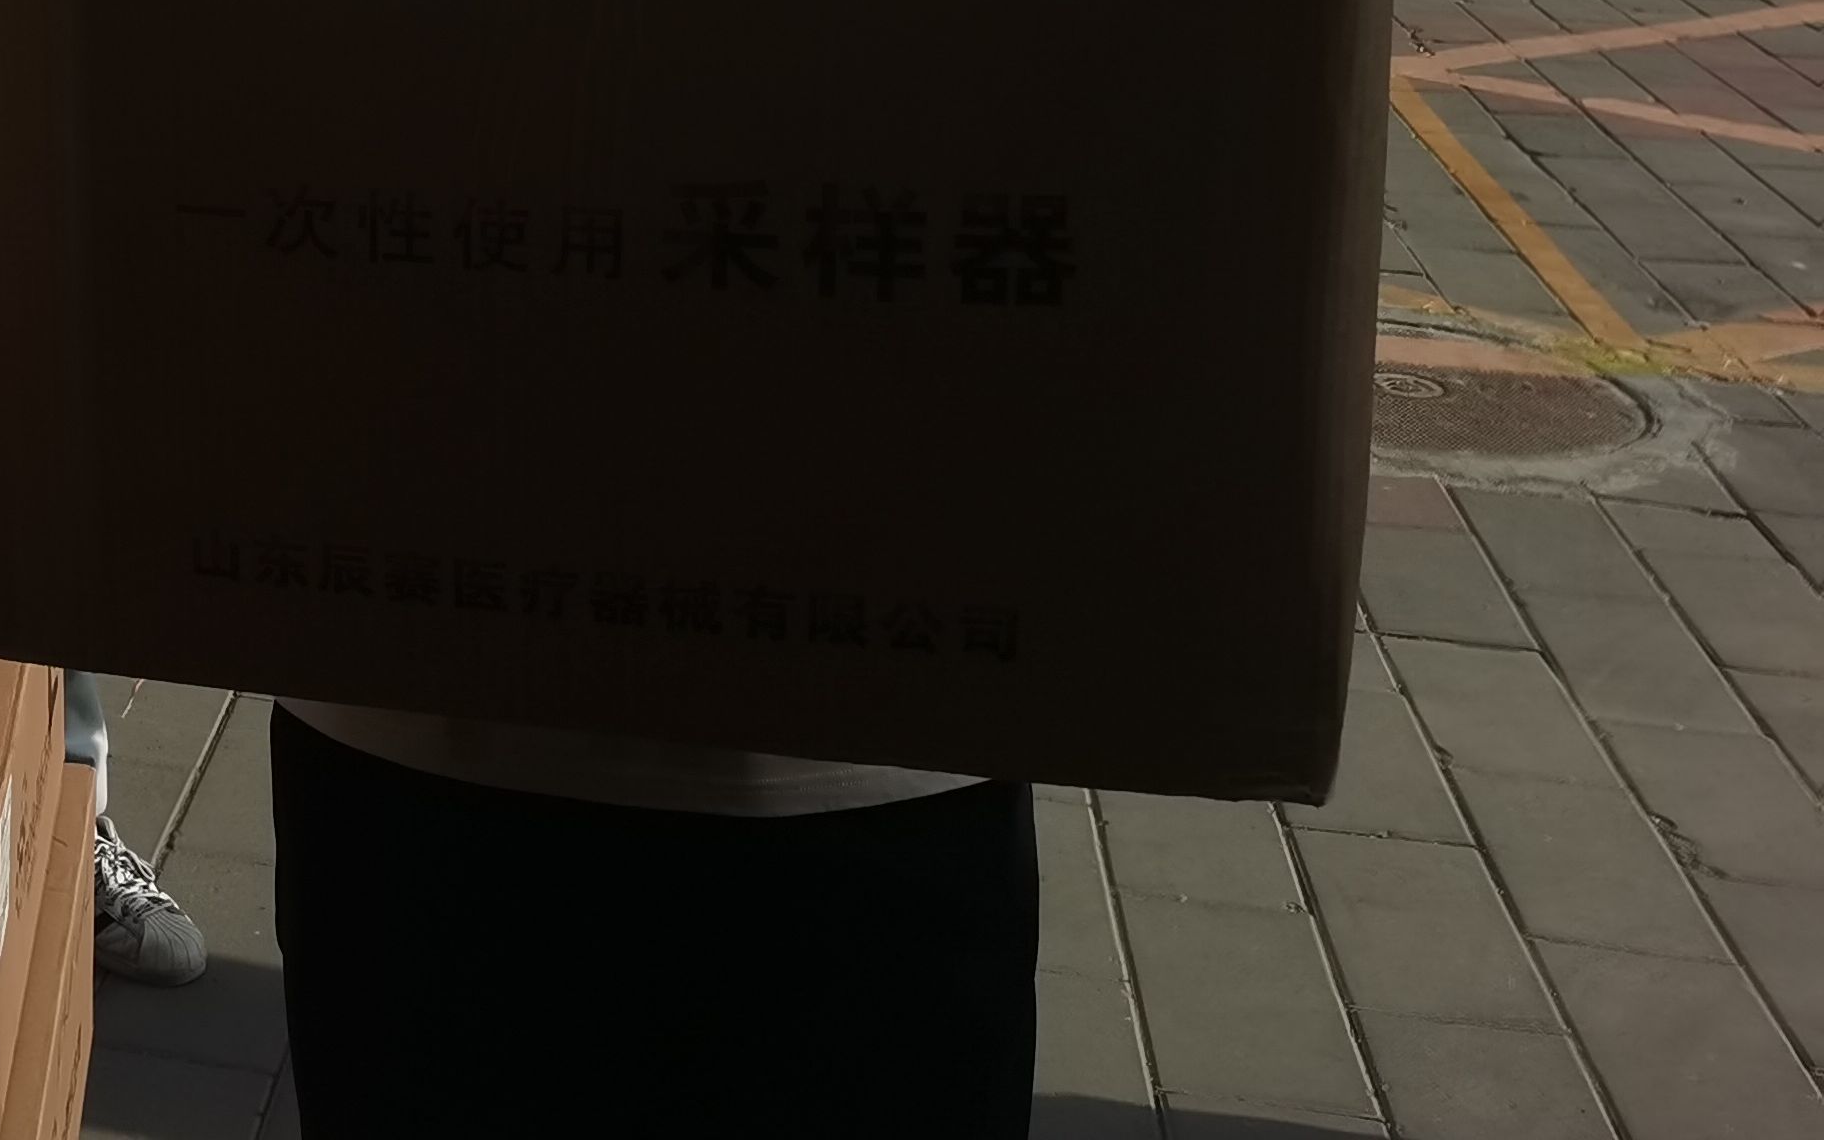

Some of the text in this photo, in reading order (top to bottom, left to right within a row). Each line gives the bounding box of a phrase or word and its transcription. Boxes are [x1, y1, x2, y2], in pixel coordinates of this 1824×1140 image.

[176, 180, 1081, 312] 一次性使用采样器
[188, 527, 1025, 663] 山东辰赛医疗器械有限公司
